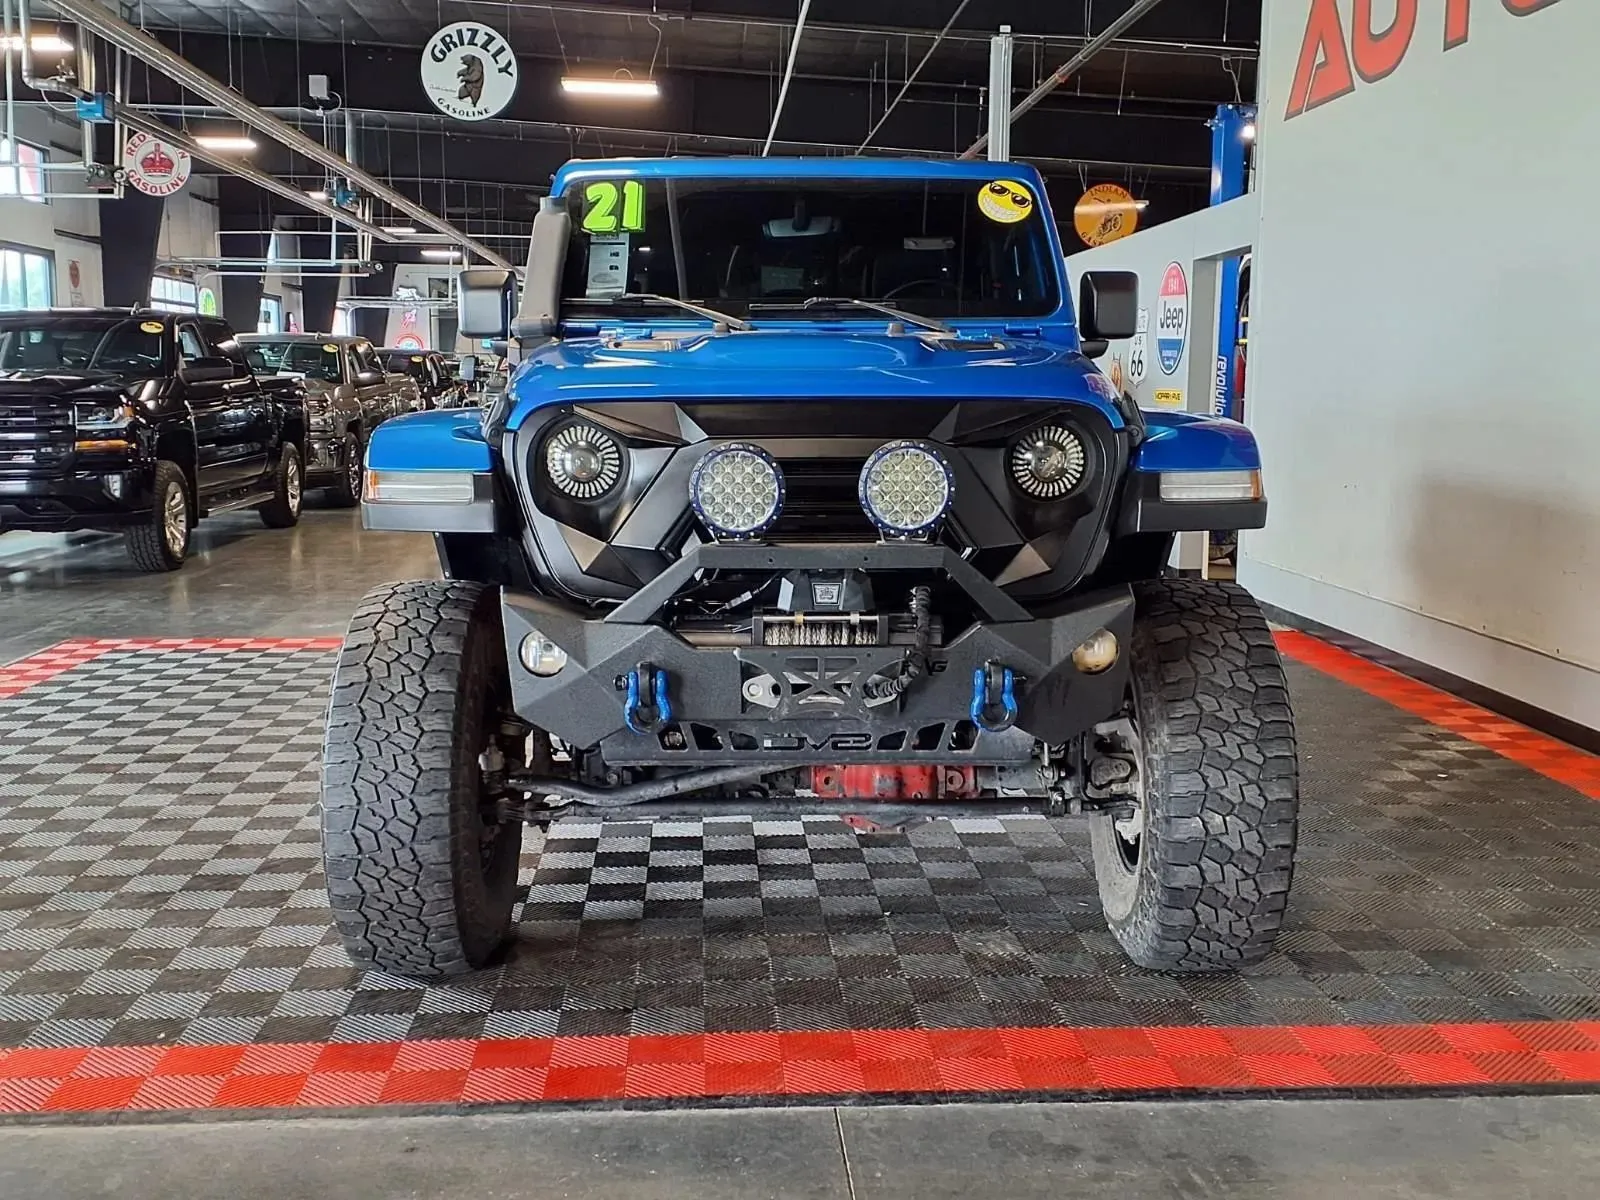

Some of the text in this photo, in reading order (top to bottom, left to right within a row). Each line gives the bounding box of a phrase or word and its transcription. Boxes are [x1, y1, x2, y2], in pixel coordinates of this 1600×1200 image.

[430, 27, 514, 78] GRIZZLY
[1284, 0, 1562, 121] AU
[437, 97, 491, 118] GASOLINE
[126, 133, 147, 157] RED
[127, 169, 187, 195] GASOLINE
[1089, 186, 1128, 198] INDIAN
[583, 180, 643, 231] 21
[1159, 300, 1184, 335] Jeep
[1130, 350, 1144, 377] 66
